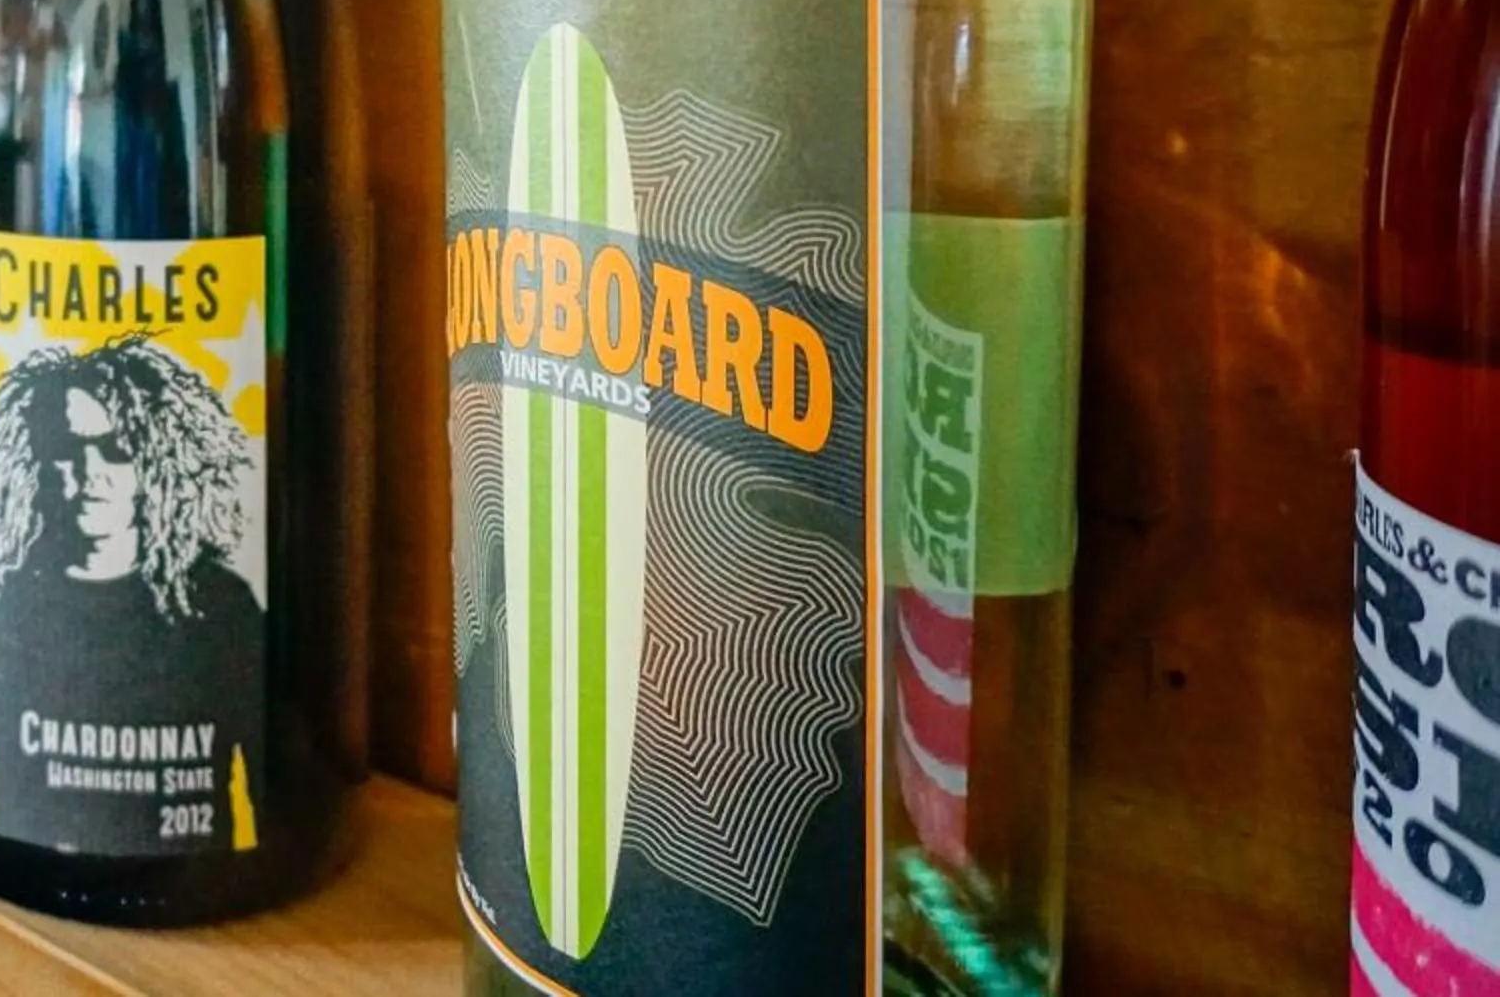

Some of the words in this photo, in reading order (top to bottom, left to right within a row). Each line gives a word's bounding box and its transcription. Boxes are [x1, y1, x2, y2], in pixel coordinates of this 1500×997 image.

[499, 349, 652, 415] VINEYARDS
[1407, 534, 1449, 586] &
[19, 709, 216, 762] CHARDONNAY
[46, 759, 157, 793] WASHINGTON
[162, 766, 215, 797] STATE
[158, 803, 214, 838] 2012
